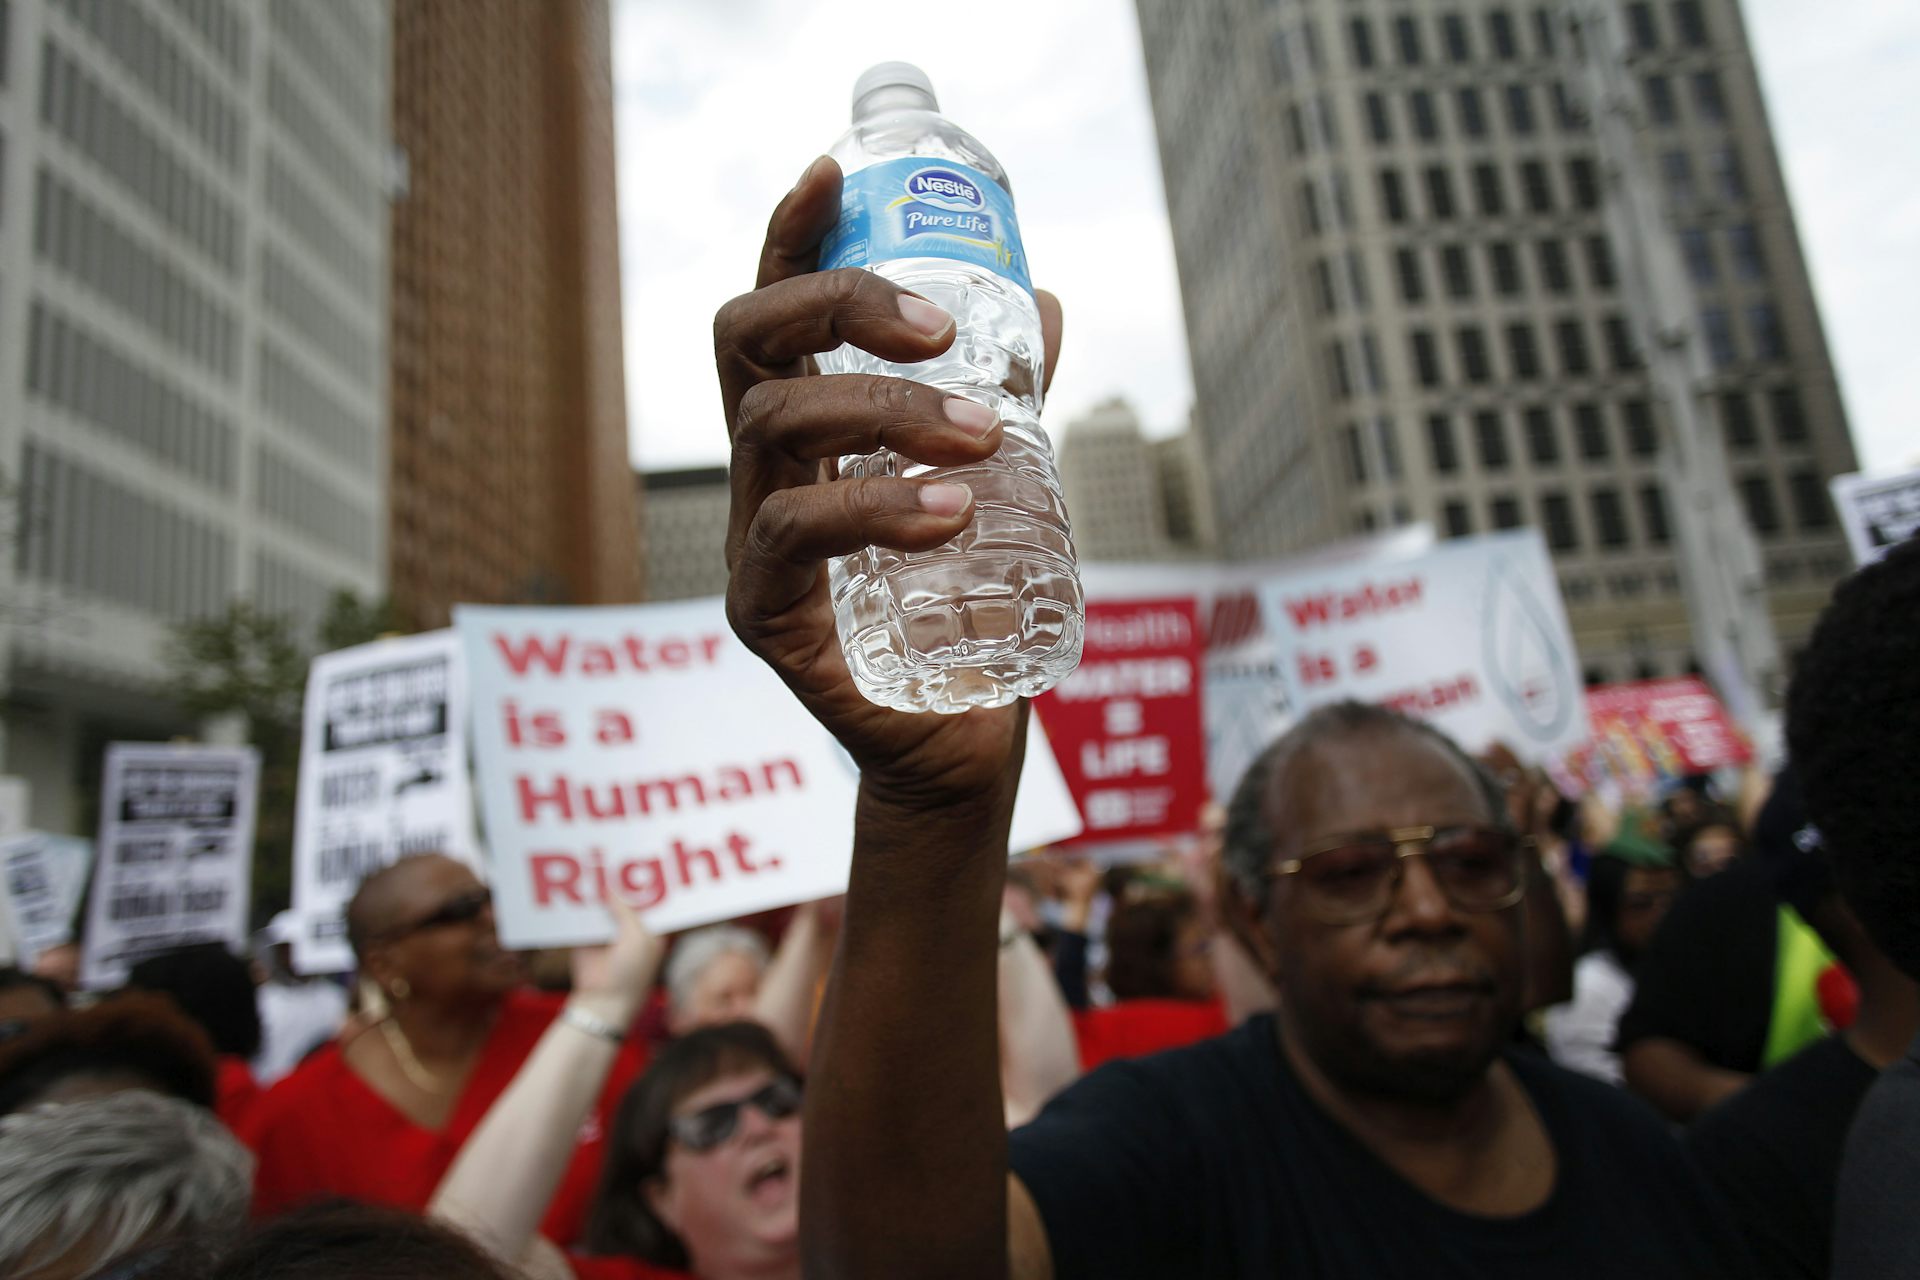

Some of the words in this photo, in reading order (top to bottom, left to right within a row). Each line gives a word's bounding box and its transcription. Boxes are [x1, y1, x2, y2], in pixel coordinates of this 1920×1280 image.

[907, 212, 955, 229] Pure
[956, 215, 989, 233] Life
[1284, 580, 1422, 630] Water
[493, 630, 723, 677] Water
[504, 700, 567, 747] is
[597, 710, 635, 745] a
[516, 759, 804, 823] Human
[529, 832, 782, 911] Right.
